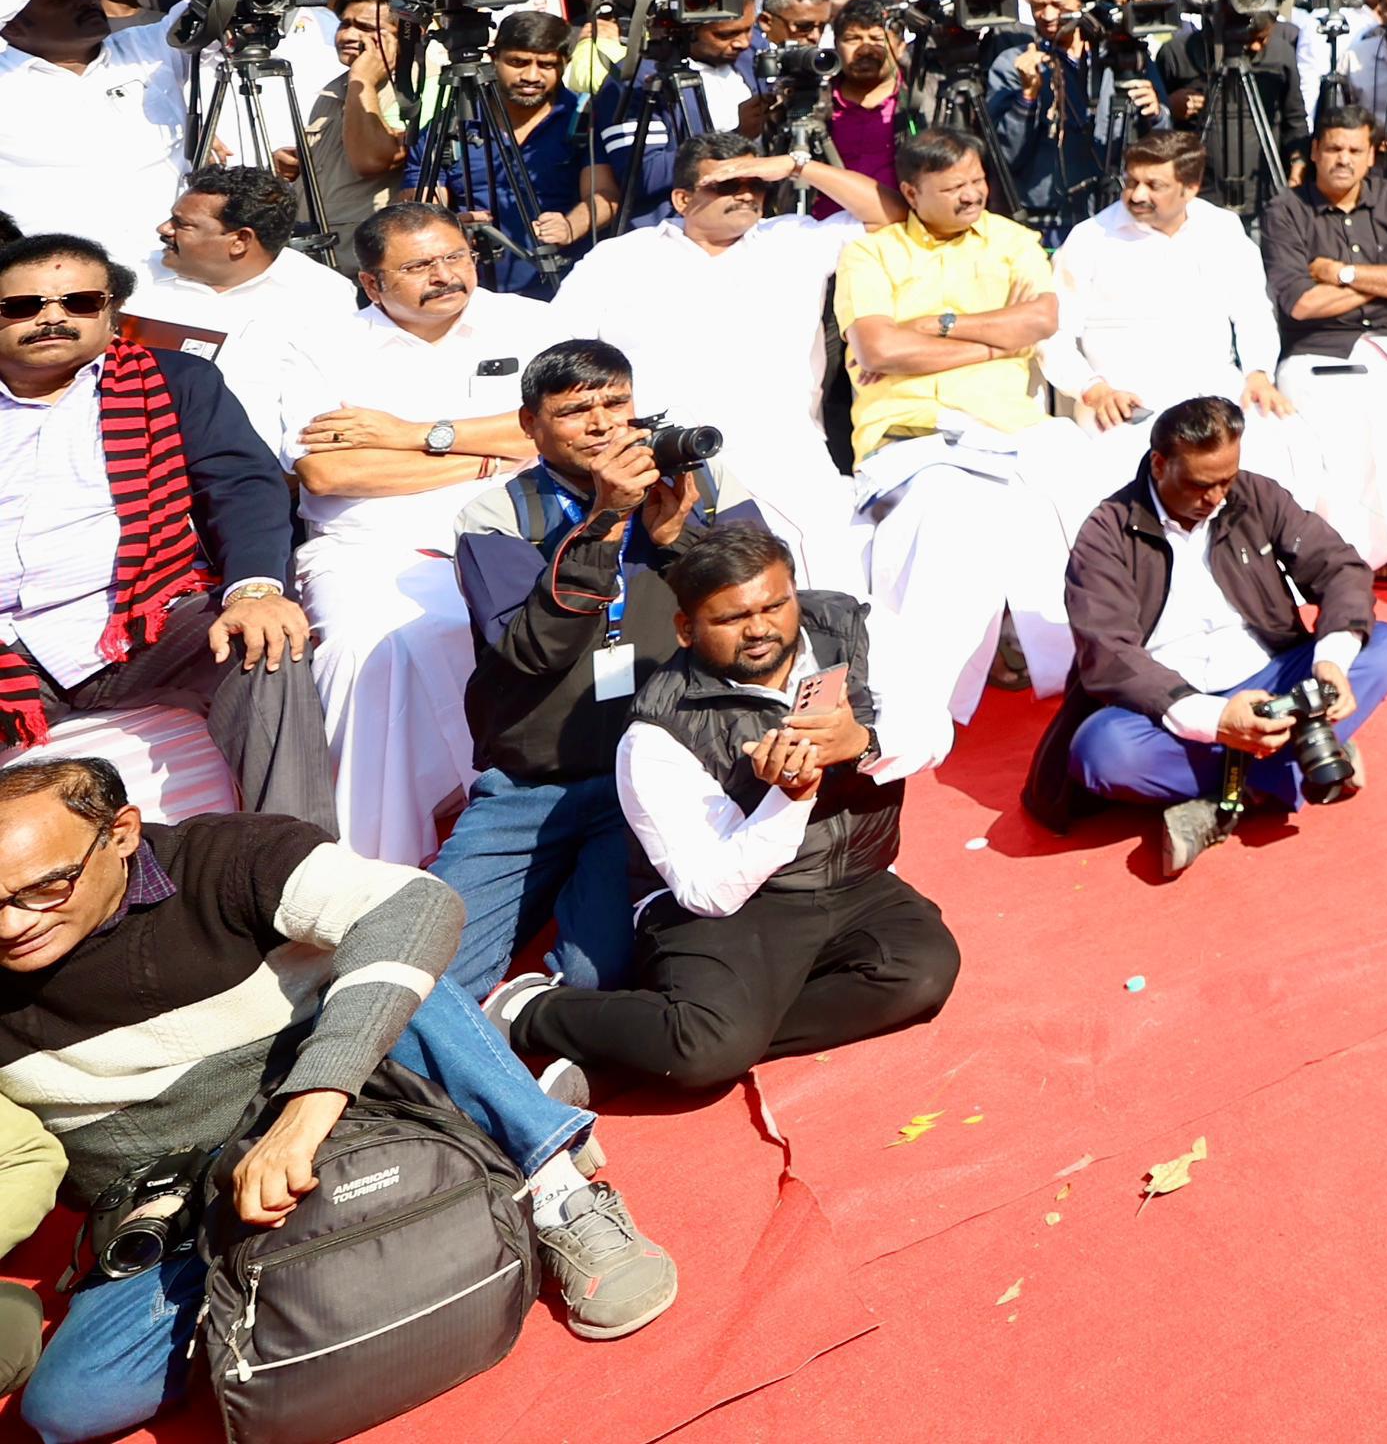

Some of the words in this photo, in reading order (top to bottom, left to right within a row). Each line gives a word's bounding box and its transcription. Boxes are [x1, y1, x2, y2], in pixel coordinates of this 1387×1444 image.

[146, 1176, 175, 1188] Canon
[332, 1174, 400, 1205] TOURISTER
[333, 1165, 400, 1196] AMERICAN
